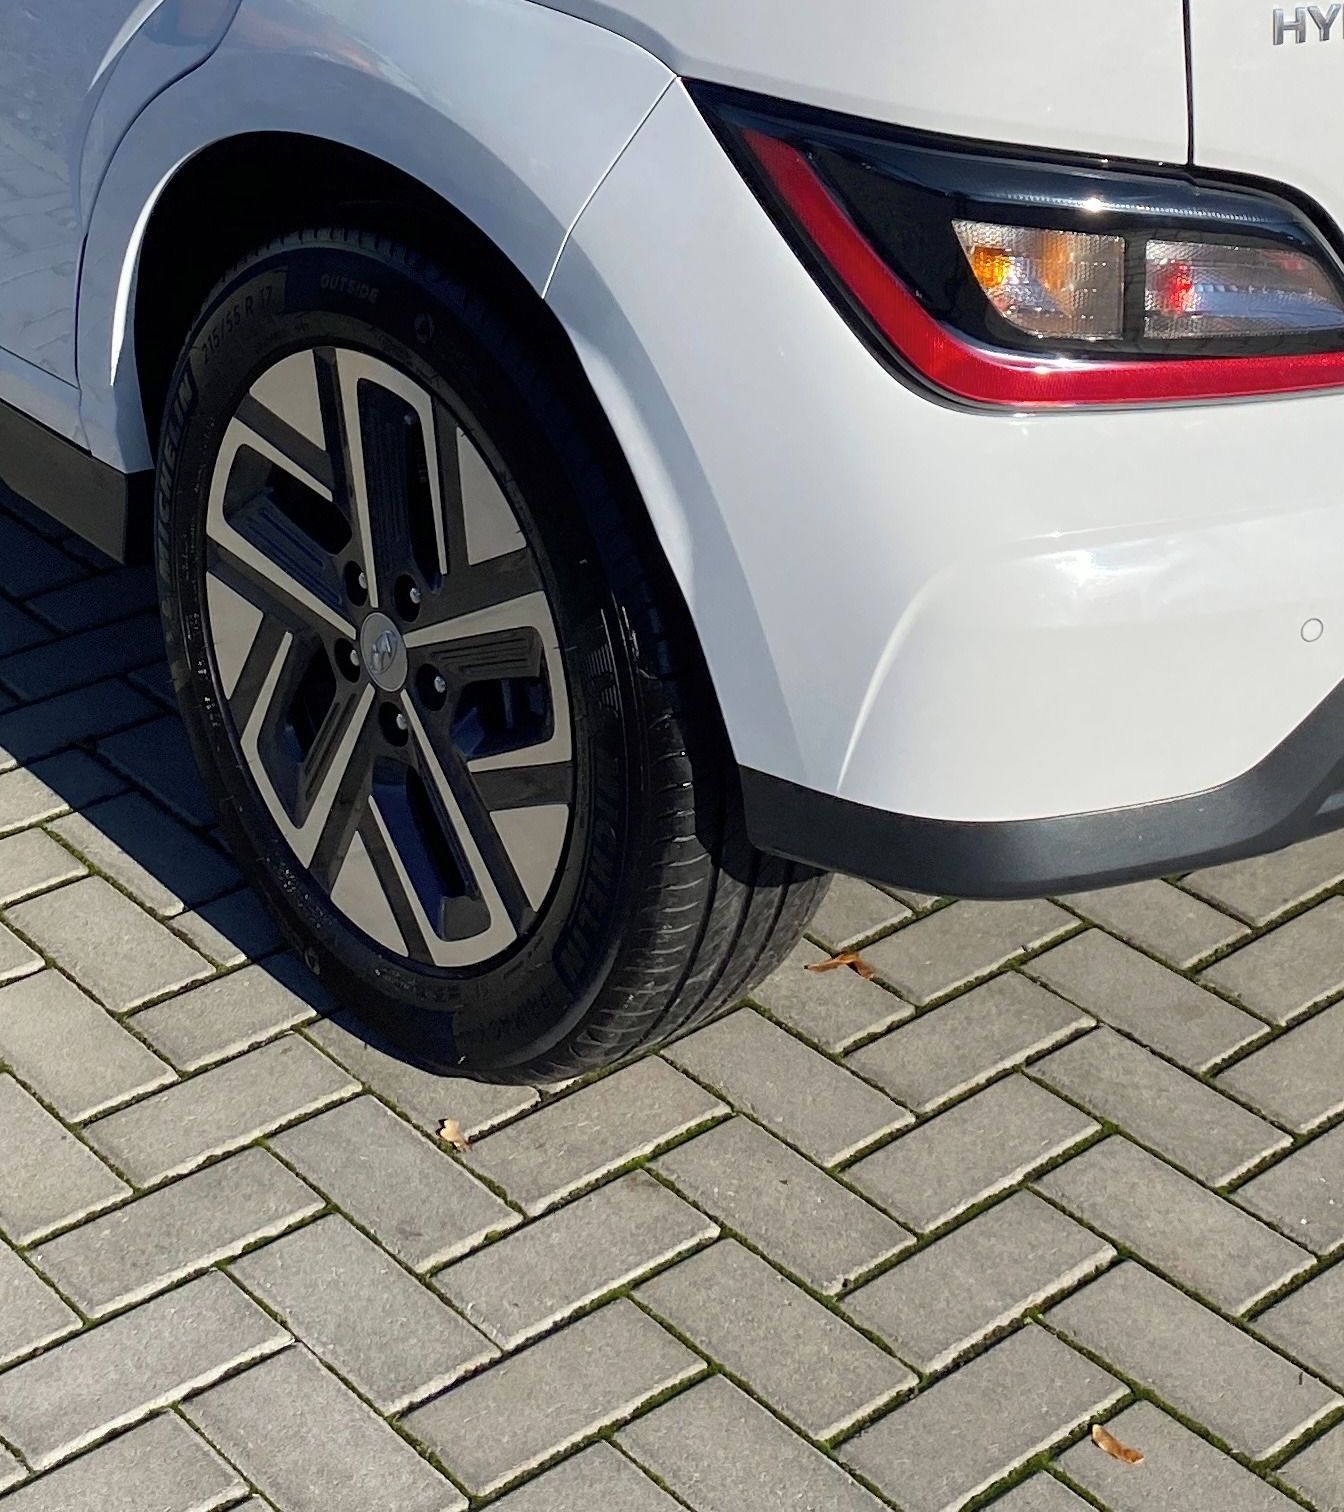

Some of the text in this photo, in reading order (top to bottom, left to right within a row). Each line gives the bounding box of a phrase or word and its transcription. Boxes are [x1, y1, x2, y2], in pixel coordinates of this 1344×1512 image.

[319, 272, 381, 305] OUTSIDE
[201, 303, 241, 365] 215/55
[244, 294, 255, 313] R
